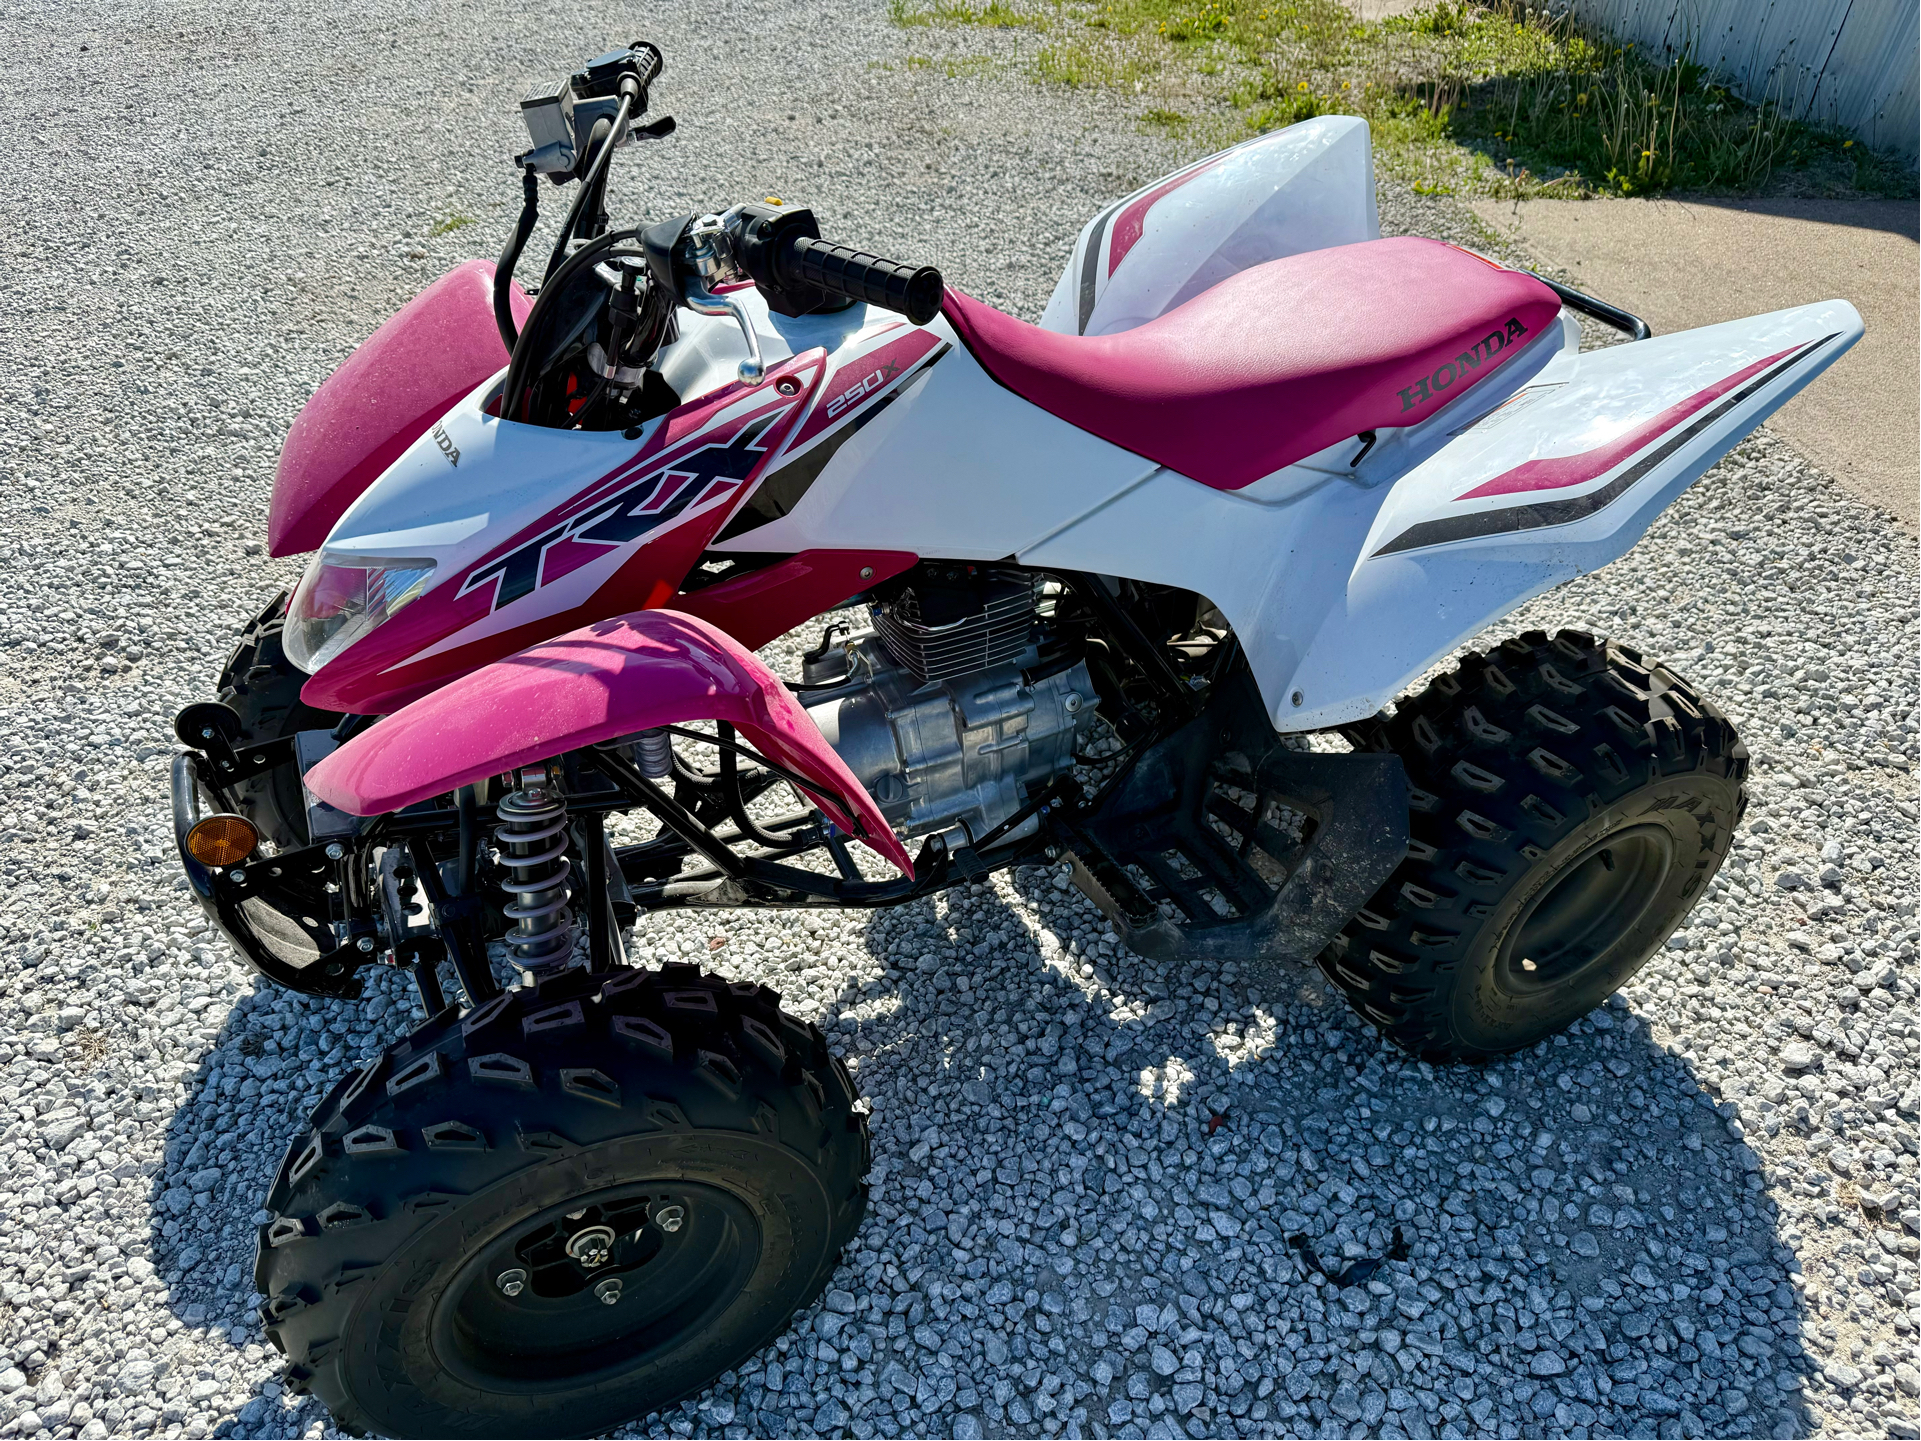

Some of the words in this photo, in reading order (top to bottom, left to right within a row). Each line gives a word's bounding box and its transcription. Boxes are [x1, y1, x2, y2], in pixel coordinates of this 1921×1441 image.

[1396, 317, 1529, 413] HONDA
[458, 406, 787, 613] TRX
[1636, 794, 1718, 900] MAXXIS
